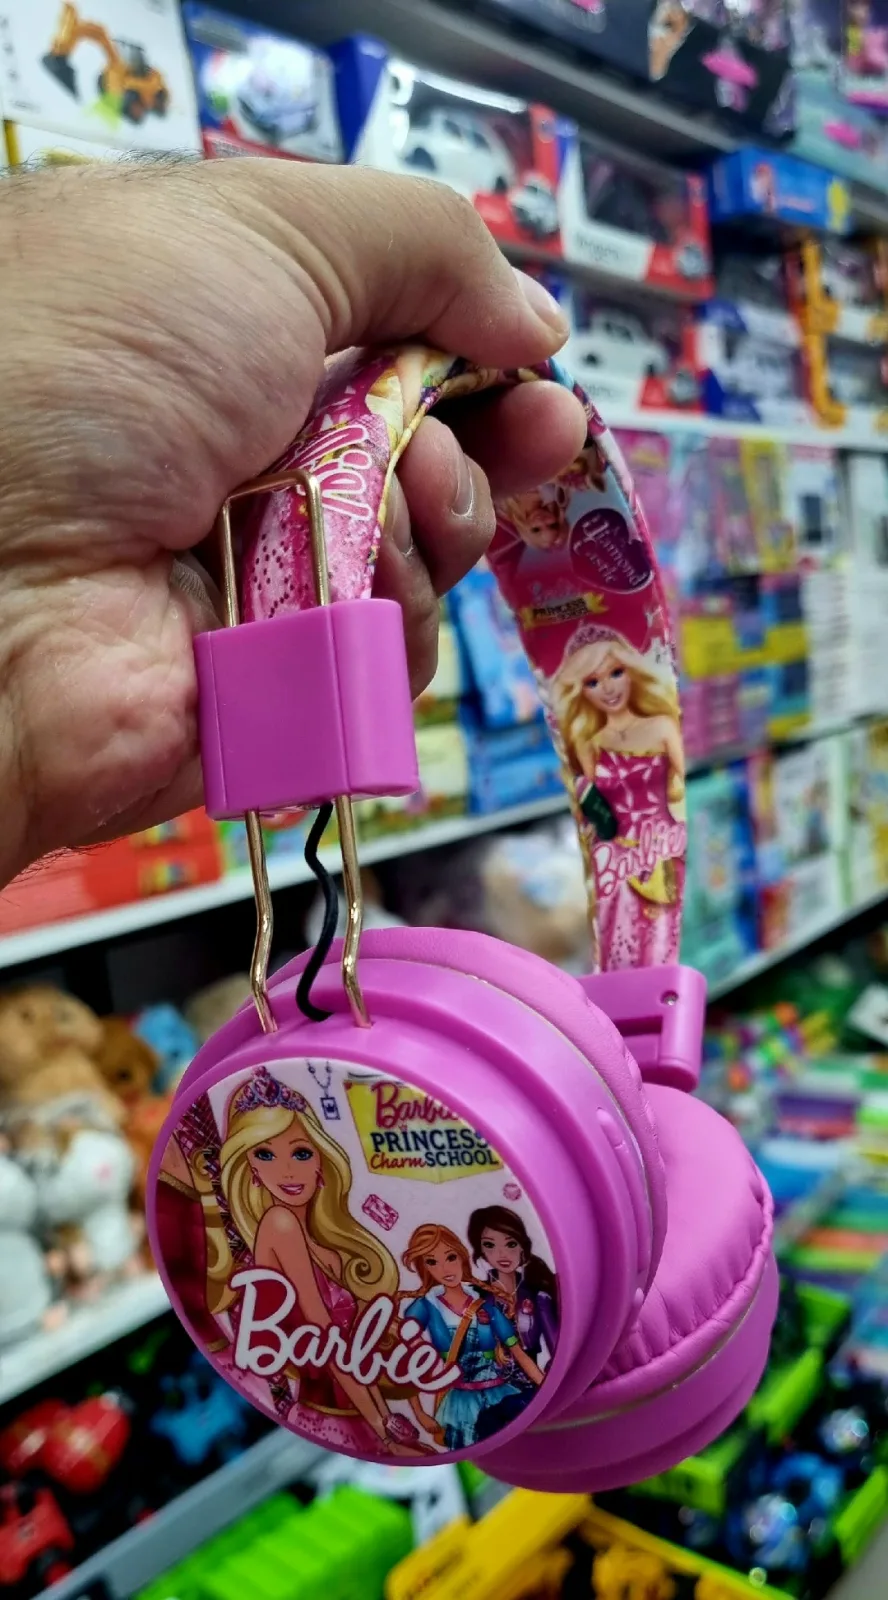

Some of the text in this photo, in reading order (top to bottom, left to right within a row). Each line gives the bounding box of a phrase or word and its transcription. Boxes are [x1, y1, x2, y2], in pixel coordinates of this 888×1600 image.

[592, 820, 688, 900] Barbie
[424, 1151, 499, 1168] SCHOOL
[230, 1268, 463, 1390] Barbie
